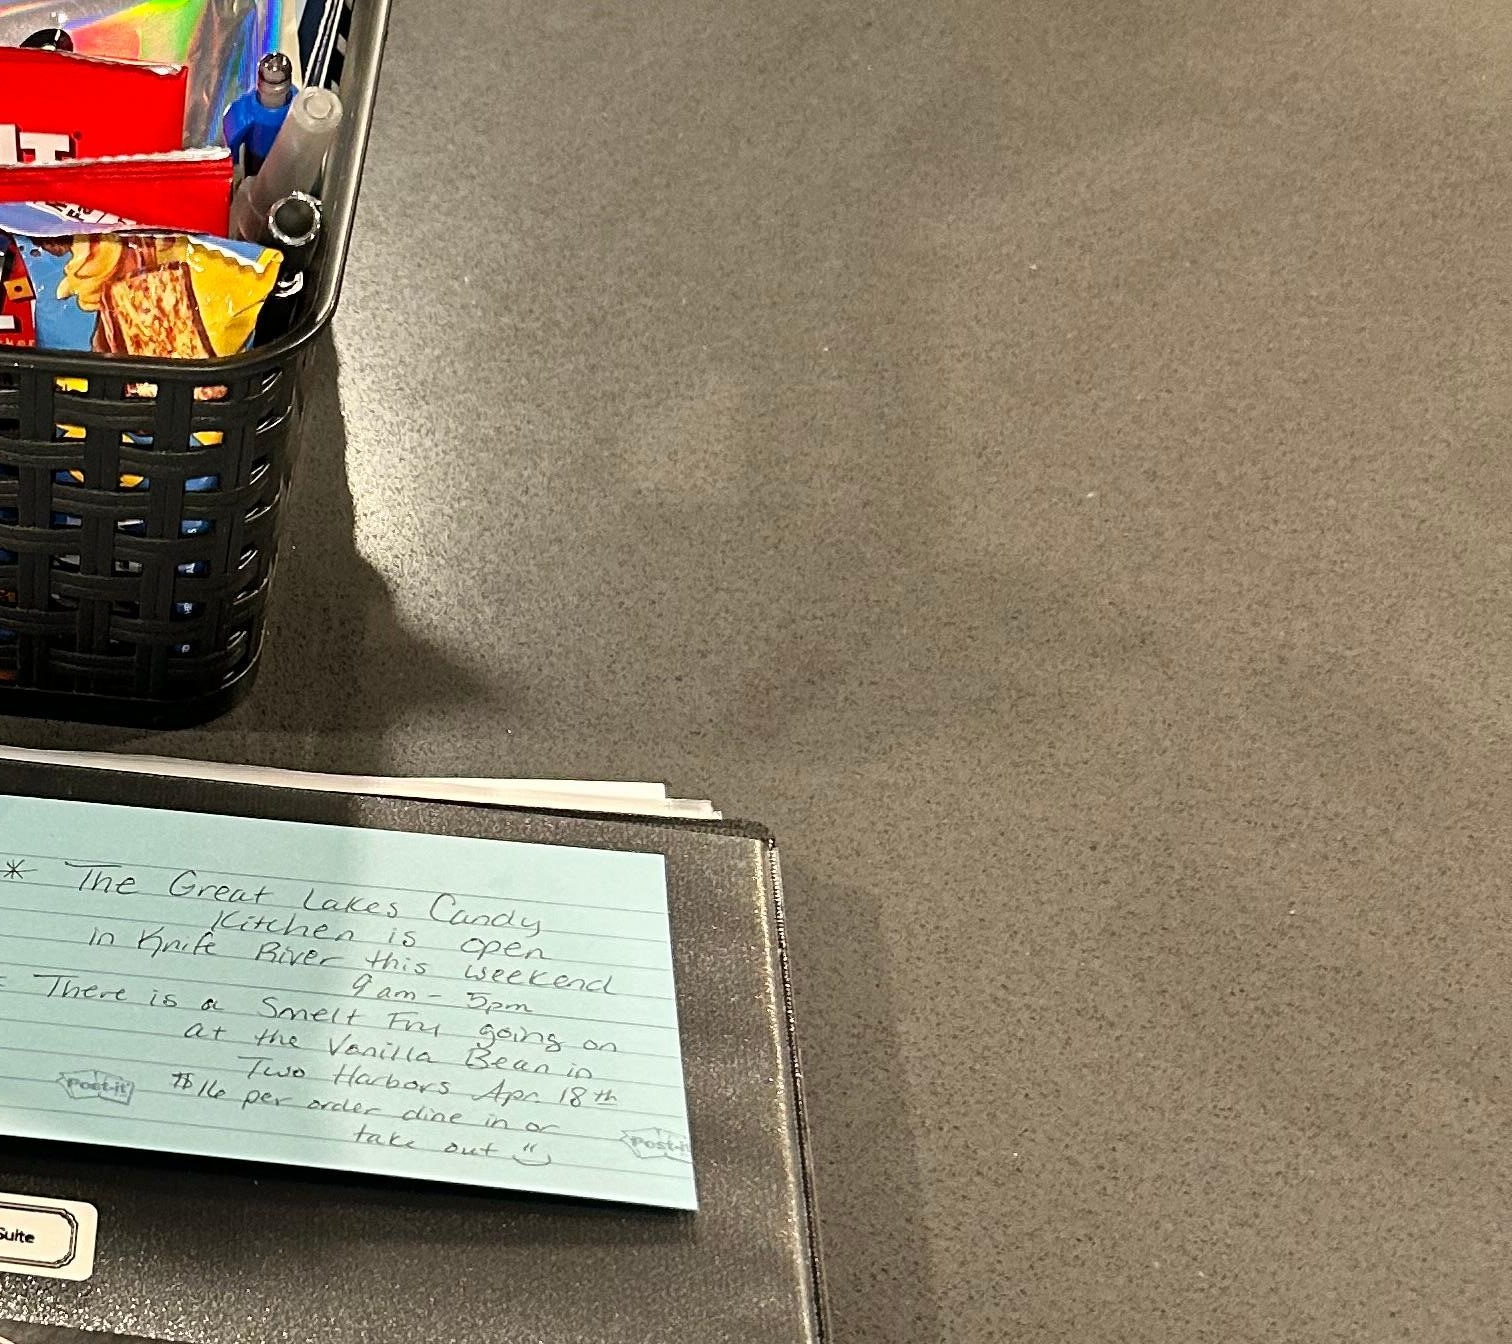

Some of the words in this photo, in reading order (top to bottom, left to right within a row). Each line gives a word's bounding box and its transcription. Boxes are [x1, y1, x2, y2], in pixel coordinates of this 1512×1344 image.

[64, 860, 138, 896] The
[169, 869, 274, 903] Great
[303, 888, 399, 919] Lakes
[429, 892, 544, 934] Candy
[88, 926, 115, 947] in
[138, 925, 217, 958] Knife
[255, 940, 342, 969] River
[365, 949, 429, 977] this
[464, 964, 618, 996] weekend
[211, 909, 355, 943] Kitchen
[388, 927, 417, 948] is
[460, 937, 552, 965] open
[33, 972, 128, 1002] There
[149, 988, 178, 1008] is
[200, 997, 224, 1012] a
[257, 996, 358, 1024] Smelt
[477, 1023, 566, 1054] going
[582, 1037, 618, 1053] on
[184, 1021, 228, 1041] at
[254, 1027, 300, 1050] the
[329, 1033, 443, 1064] Vanilla
[465, 1047, 551, 1076] Bean
[566, 1058, 594, 1080] in
[238, 1056, 307, 1080] Two
[332, 1063, 452, 1096] Harbors
[241, 1088, 292, 1110] per
[307, 1096, 384, 1117] order
[401, 1106, 464, 1126] dine
[484, 1112, 508, 1131] in
[524, 1119, 561, 1135] or
[353, 1124, 417, 1150] take
[443, 1140, 499, 1157] out
